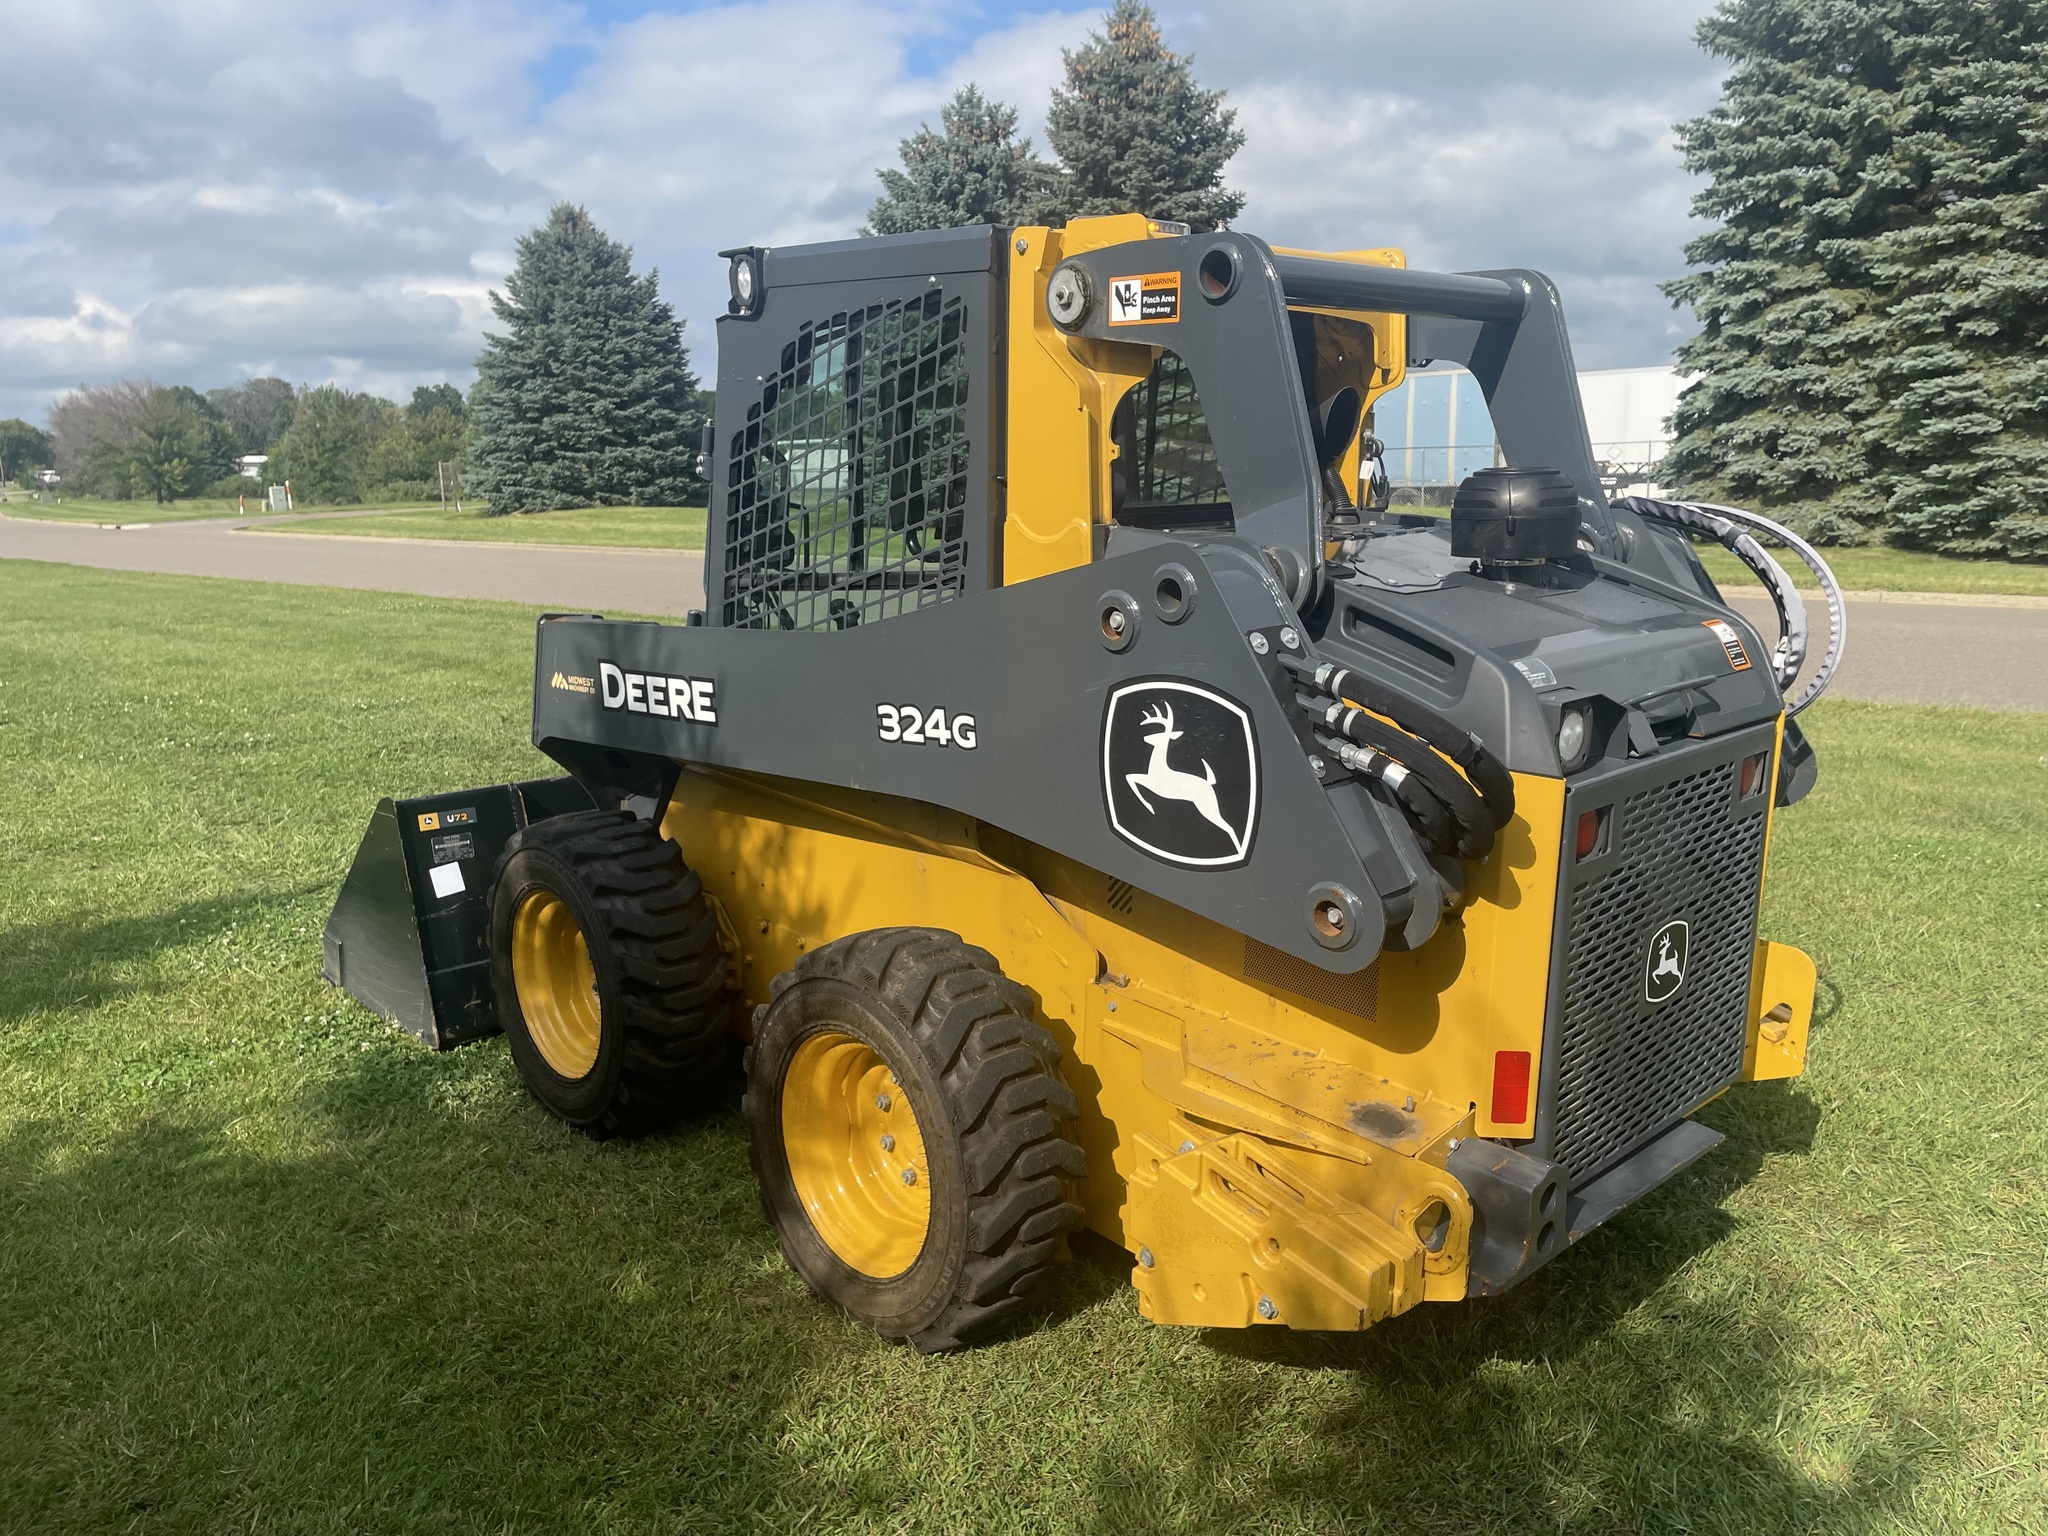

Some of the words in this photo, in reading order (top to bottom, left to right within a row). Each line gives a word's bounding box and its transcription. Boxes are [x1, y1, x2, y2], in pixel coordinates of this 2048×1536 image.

[1150, 277, 1177, 285] WARNING
[1142, 295, 1160, 304] Pinch
[1161, 295, 1176, 303] Area
[1142, 306, 1156, 314] Keep
[567, 675, 595, 687] MIDWEST
[599, 662, 717, 723] DEERE
[876, 703, 977, 749] 324G
[446, 812, 468, 823] U72
